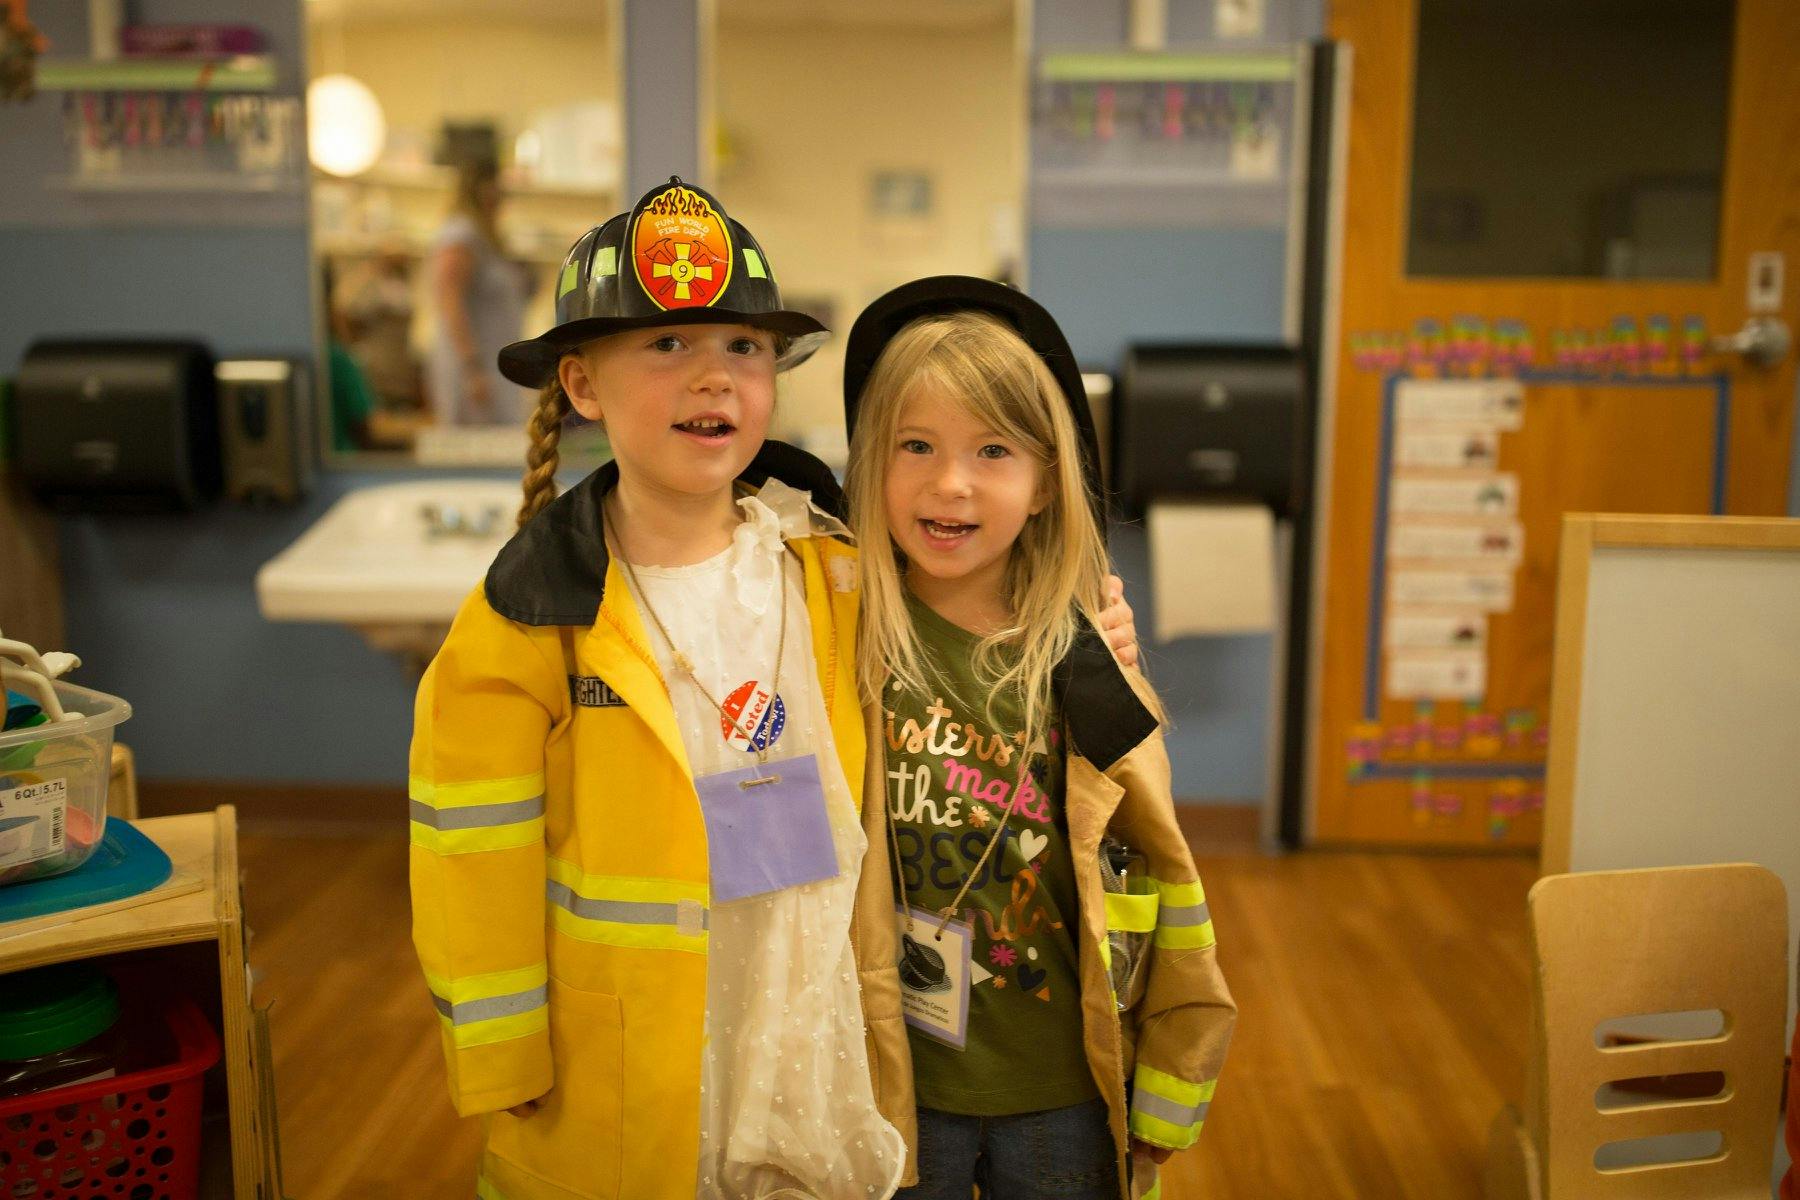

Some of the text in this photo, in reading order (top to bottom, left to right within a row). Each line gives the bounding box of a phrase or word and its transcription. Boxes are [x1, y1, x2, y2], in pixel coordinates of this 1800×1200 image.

[655, 217, 709, 233] FUN WORLD
[659, 226, 680, 236] FIRE
[679, 265, 688, 278] 9
[886, 698, 1015, 767] isters
[888, 762, 963, 827] the
